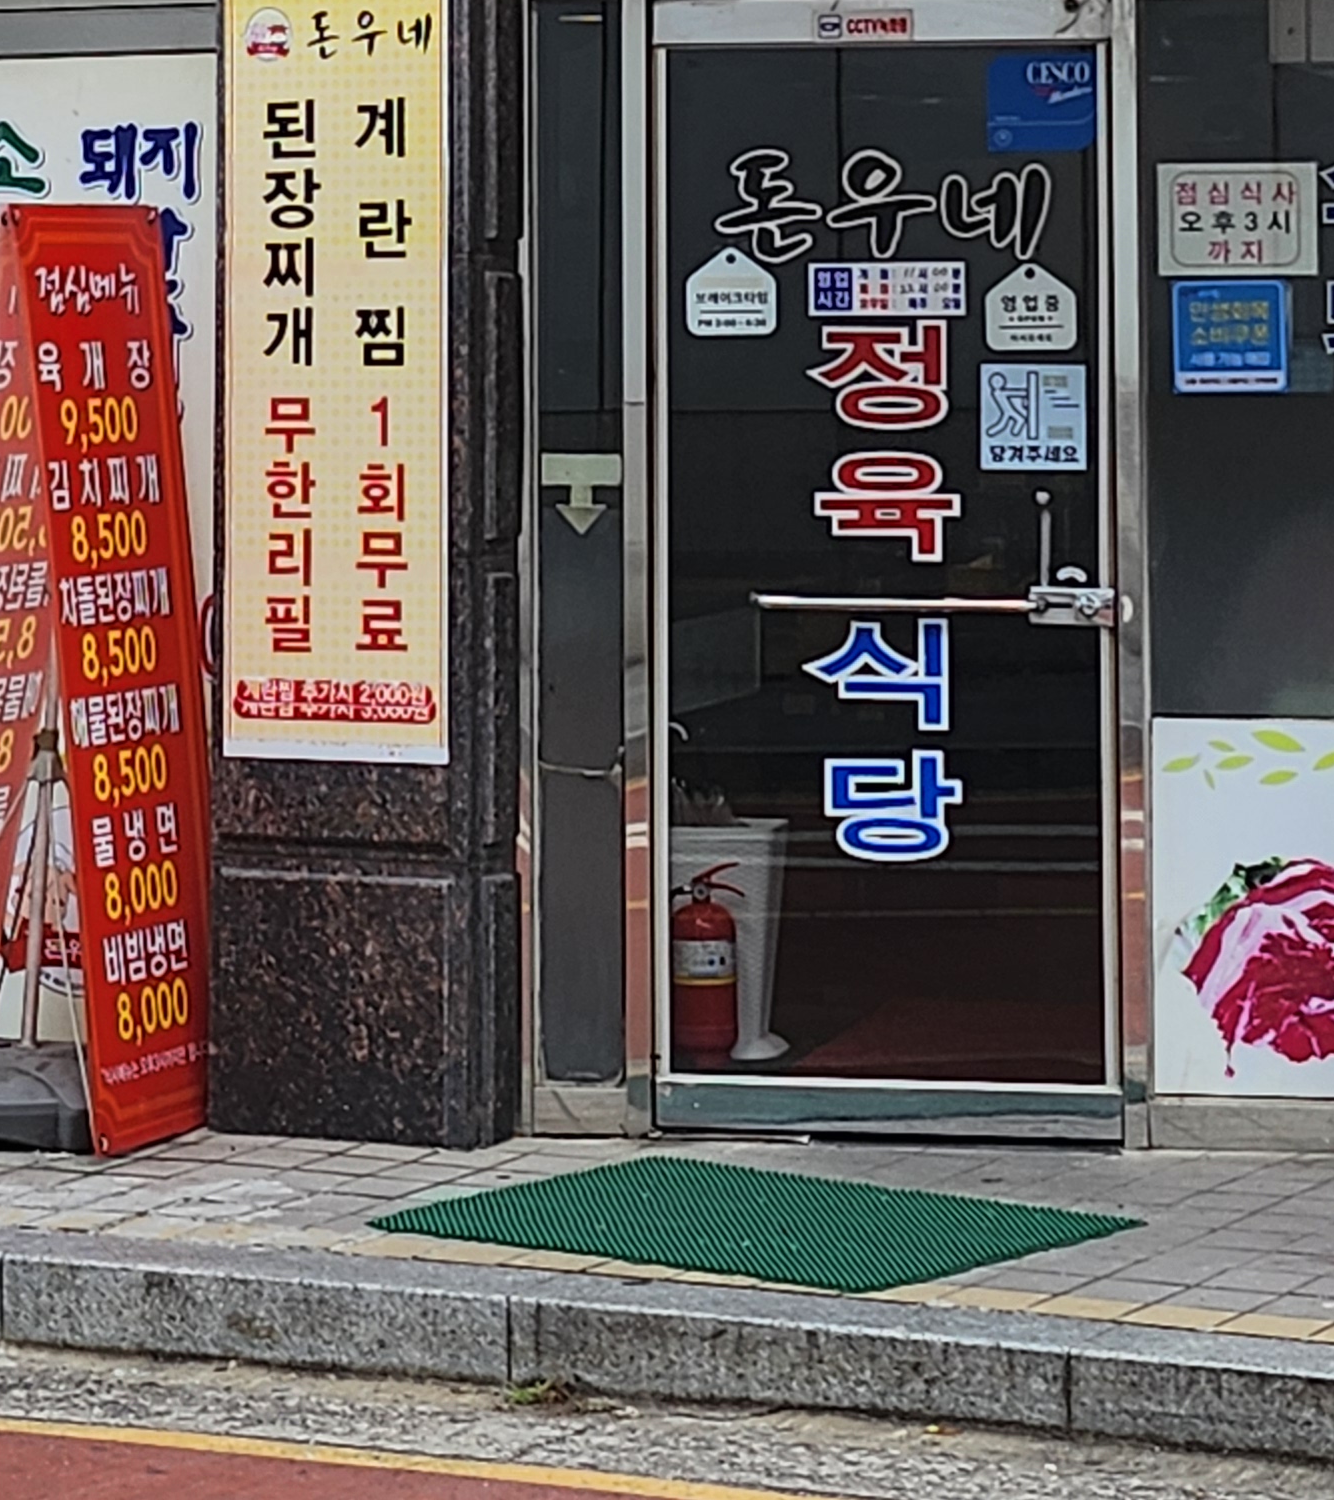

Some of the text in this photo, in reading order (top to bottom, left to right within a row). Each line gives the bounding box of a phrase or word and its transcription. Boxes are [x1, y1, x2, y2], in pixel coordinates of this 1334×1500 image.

[307, 10, 432, 59] 돈우네
[714, 148, 1051, 263] 돈우네
[1174, 181, 1297, 207] 점심식사
[264, 99, 320, 367] 된장찌개
[354, 96, 412, 367] 계란찜
[1208, 239, 1265, 264] 까지
[34, 263, 141, 315] 점심메뉴
[817, 271, 850, 288] 영업
[817, 291, 850, 308] 시간
[1000, 295, 1060, 313] 영업중
[37, 339, 151, 393] 육개장
[60, 395, 138, 450] 9,500
[48, 454, 161, 511] 김치찌개
[70, 509, 148, 570] 8,500
[264, 396, 317, 655] 무한리필
[58, 566, 171, 627] 차돌된장찌개
[81, 624, 157, 687] 8,500
[69, 683, 180, 748] 해물된장찌개
[93, 743, 167, 808] 8,500
[92, 801, 179, 869] 물냉면
[104, 859, 178, 927] 8,000
[102, 918, 189, 986] 비빔냉면
[117, 976, 189, 1046] 8,000
